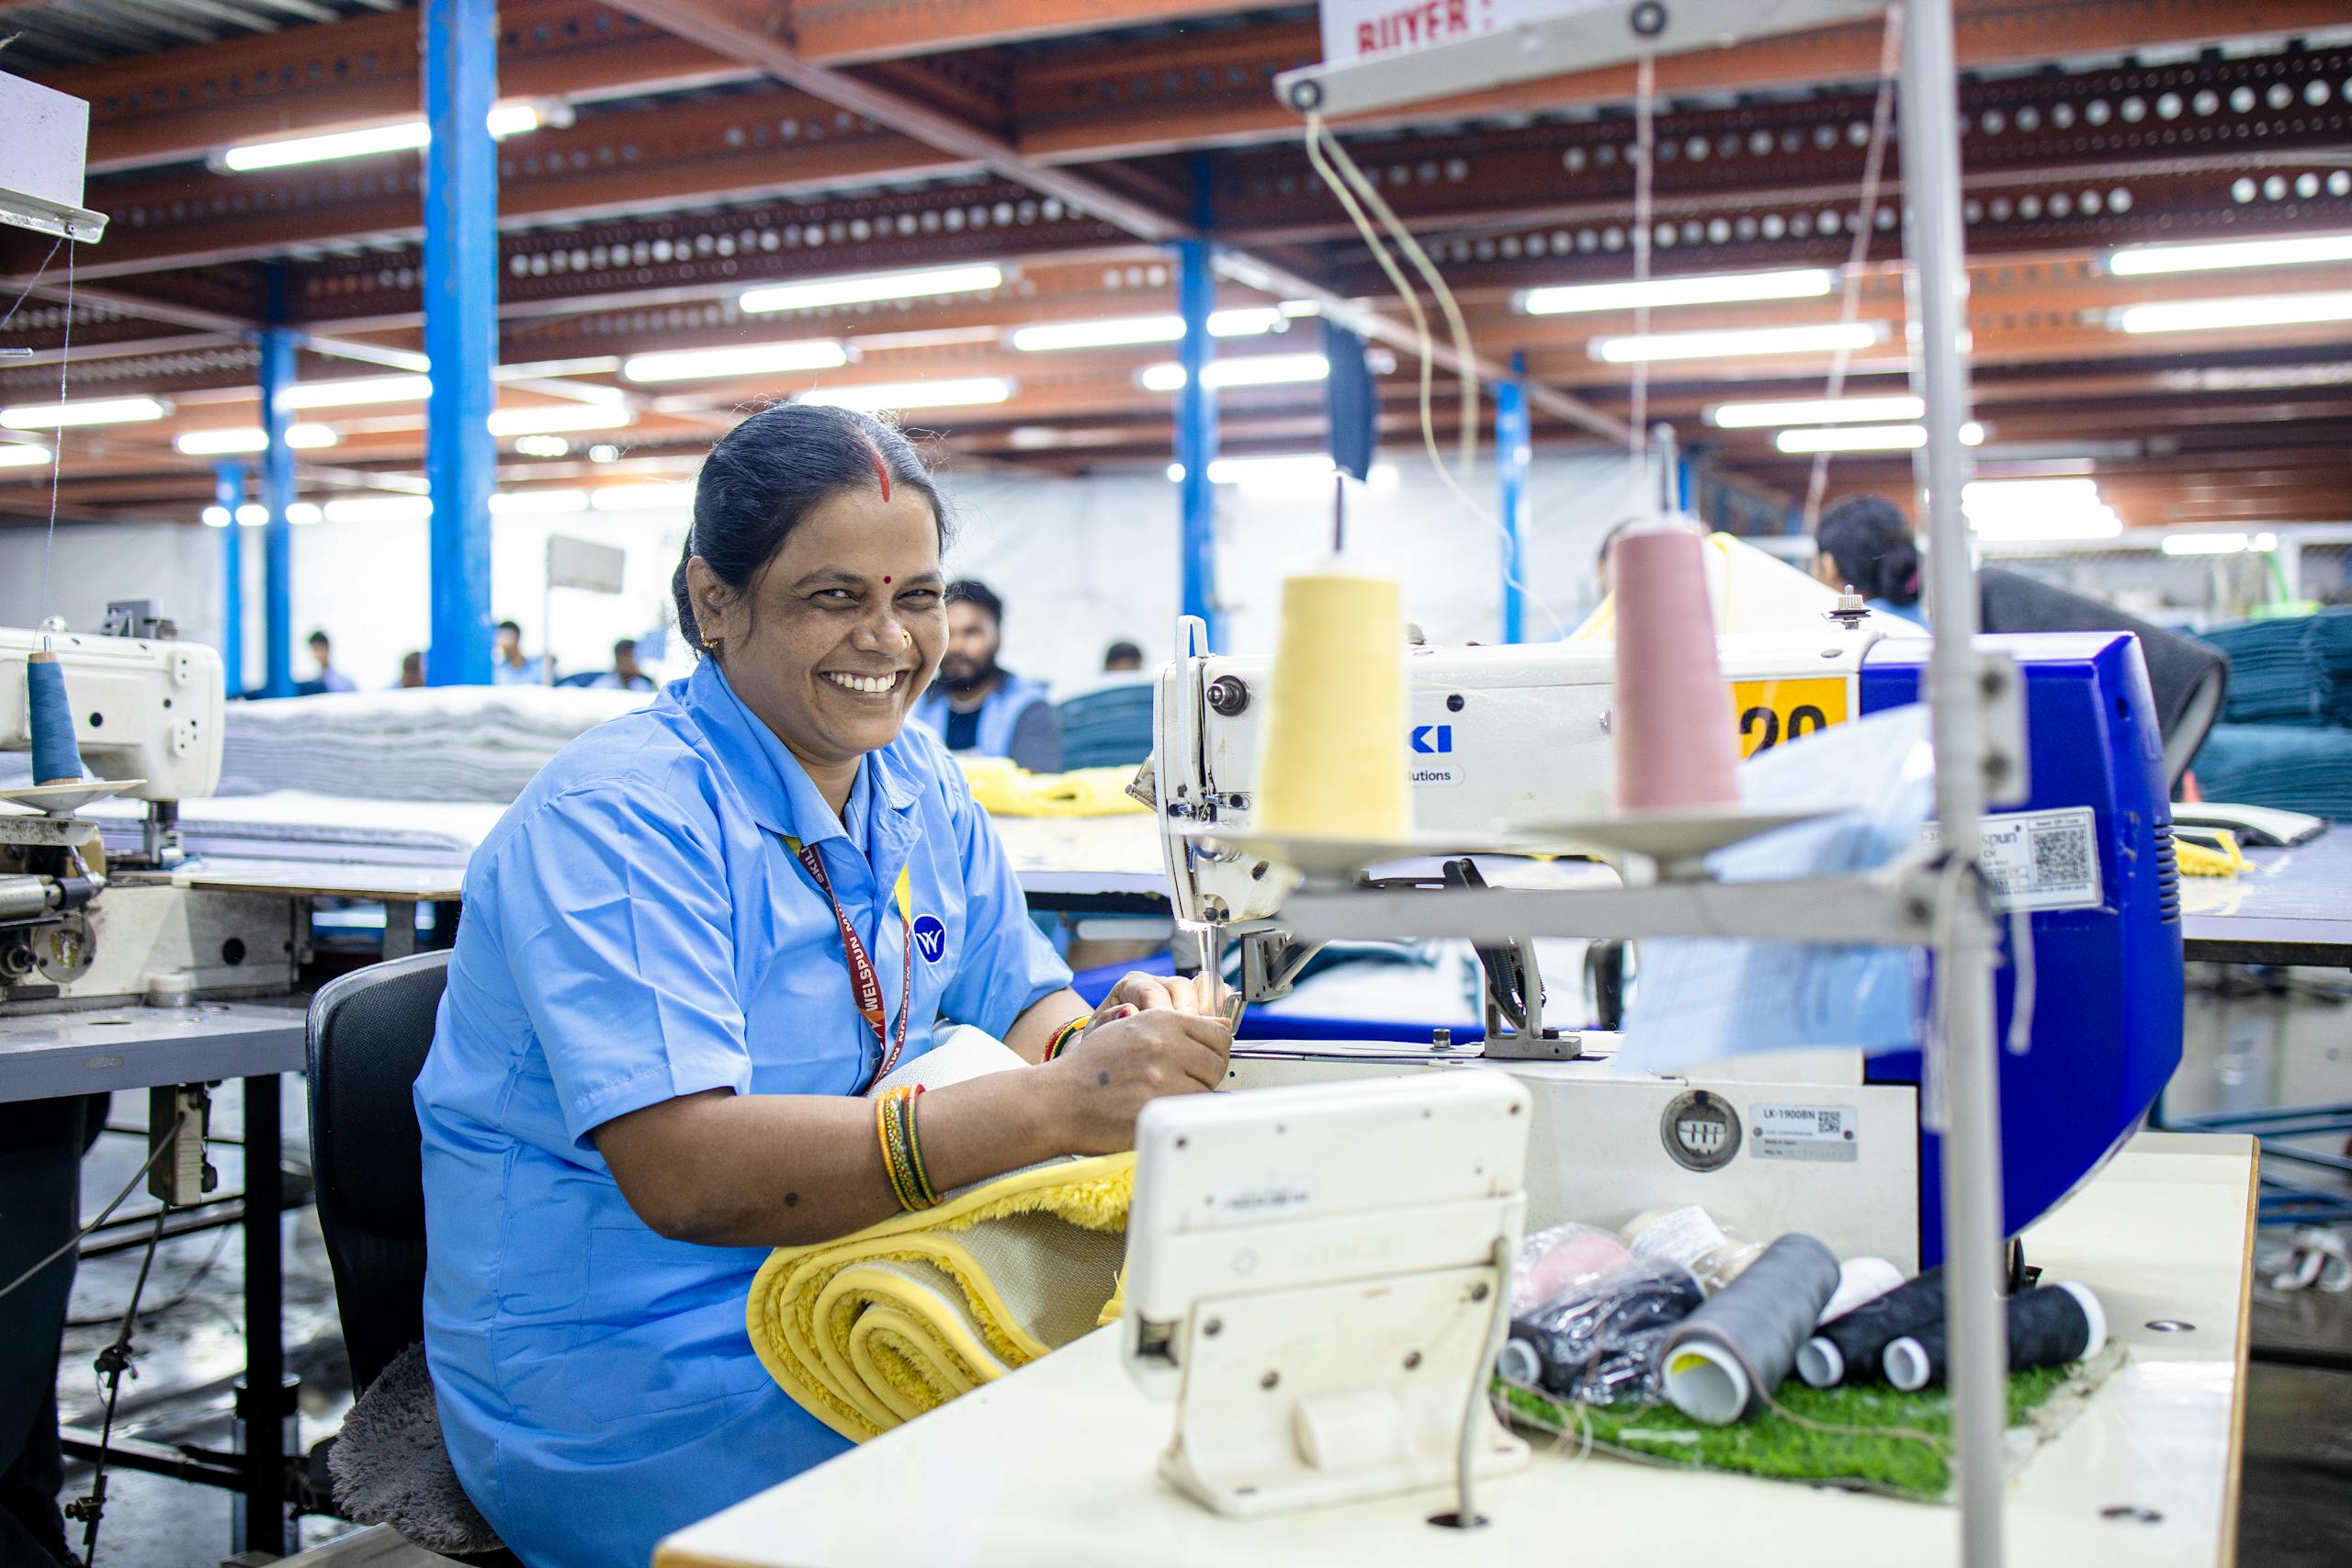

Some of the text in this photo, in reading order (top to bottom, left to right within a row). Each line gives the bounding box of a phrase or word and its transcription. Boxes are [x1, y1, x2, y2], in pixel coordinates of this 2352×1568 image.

[1409, 725, 1453, 753] KI
[1408, 770, 1451, 781] lutions
[850, 936, 879, 1012] WELSPUN
